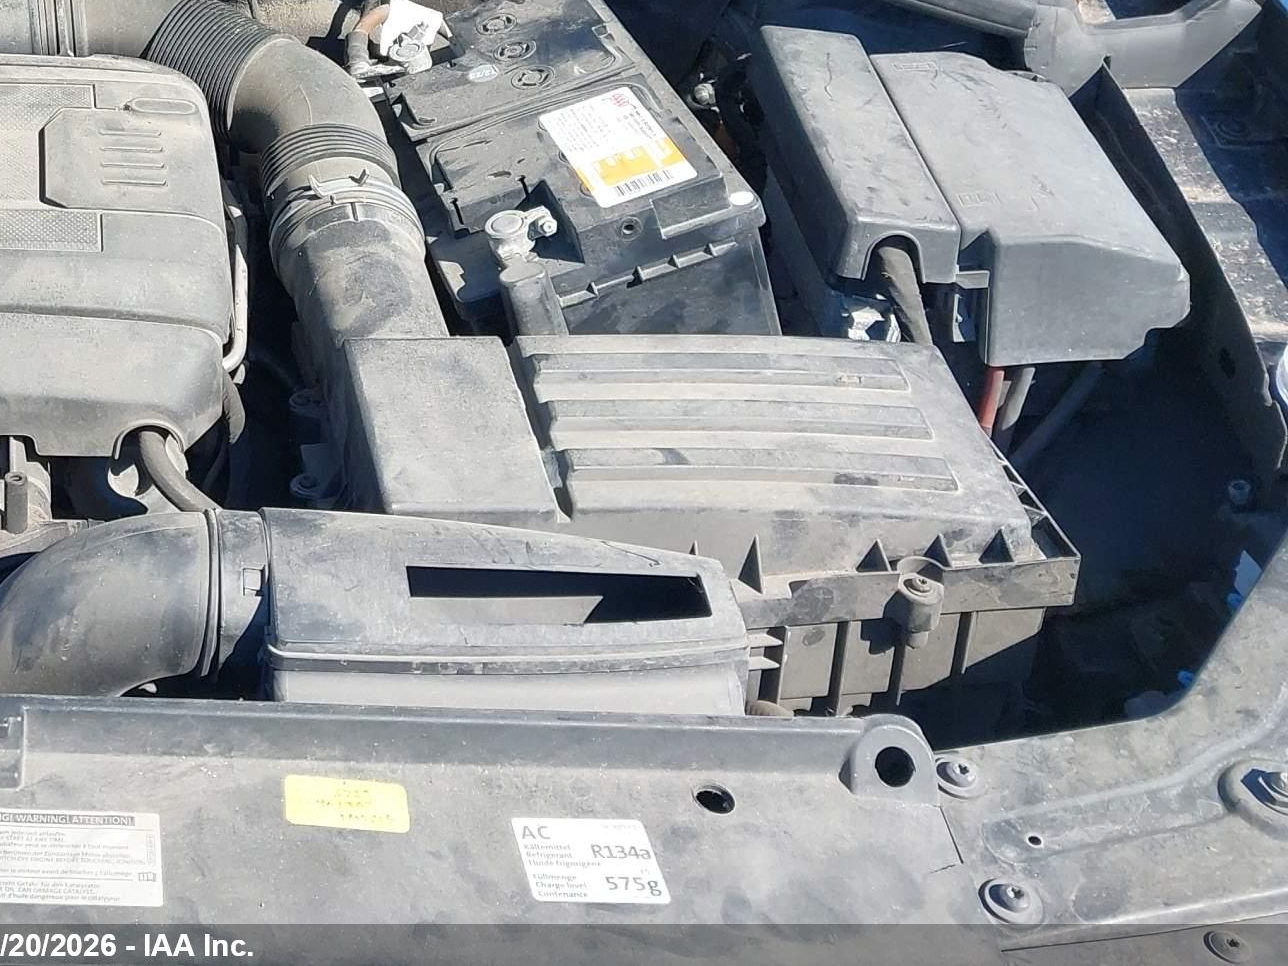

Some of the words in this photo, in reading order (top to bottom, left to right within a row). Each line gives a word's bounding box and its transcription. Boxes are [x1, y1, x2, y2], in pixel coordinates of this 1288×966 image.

[15, 813, 70, 824] WARNING!
[71, 815, 132, 826] ATTENTION!
[521, 825, 551, 840] AC
[590, 843, 652, 860] R134a
[605, 876, 662, 898] 575g
